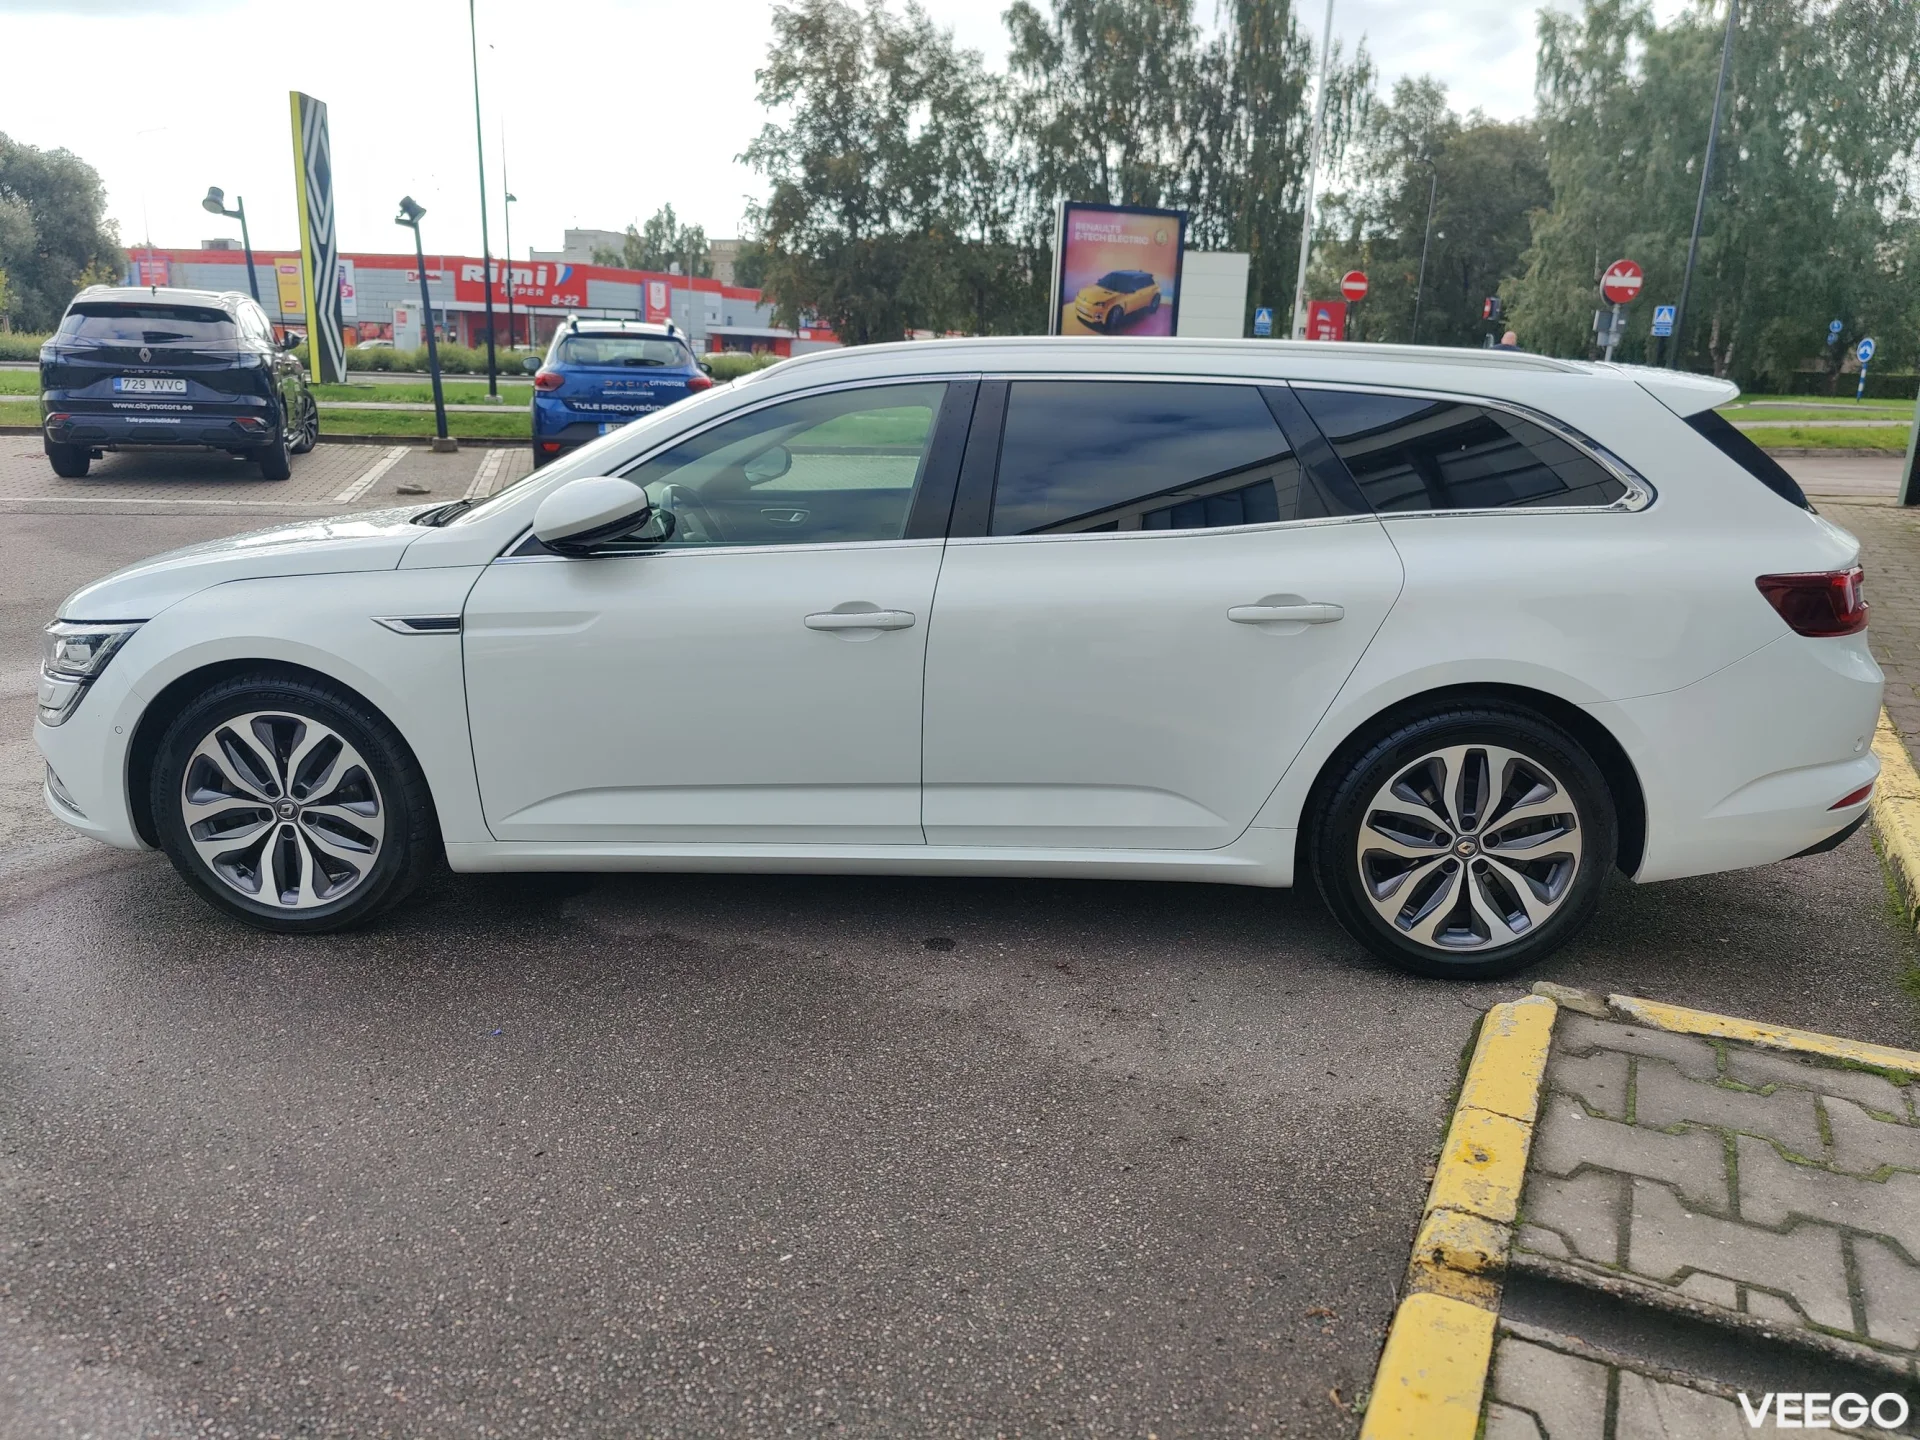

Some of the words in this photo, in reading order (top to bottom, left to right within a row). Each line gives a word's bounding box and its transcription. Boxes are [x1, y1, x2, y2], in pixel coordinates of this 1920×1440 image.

[1074, 231, 1106, 242] E-TECH
[1107, 233, 1149, 245] ELECTRIC
[461, 262, 547, 286] Rimi
[551, 295, 579, 305] 8-22
[123, 379, 146, 390] 729
[152, 380, 184, 391] WVC
[604, 380, 651, 388] DACIA
[649, 380, 686, 388] CITYMOTORS
